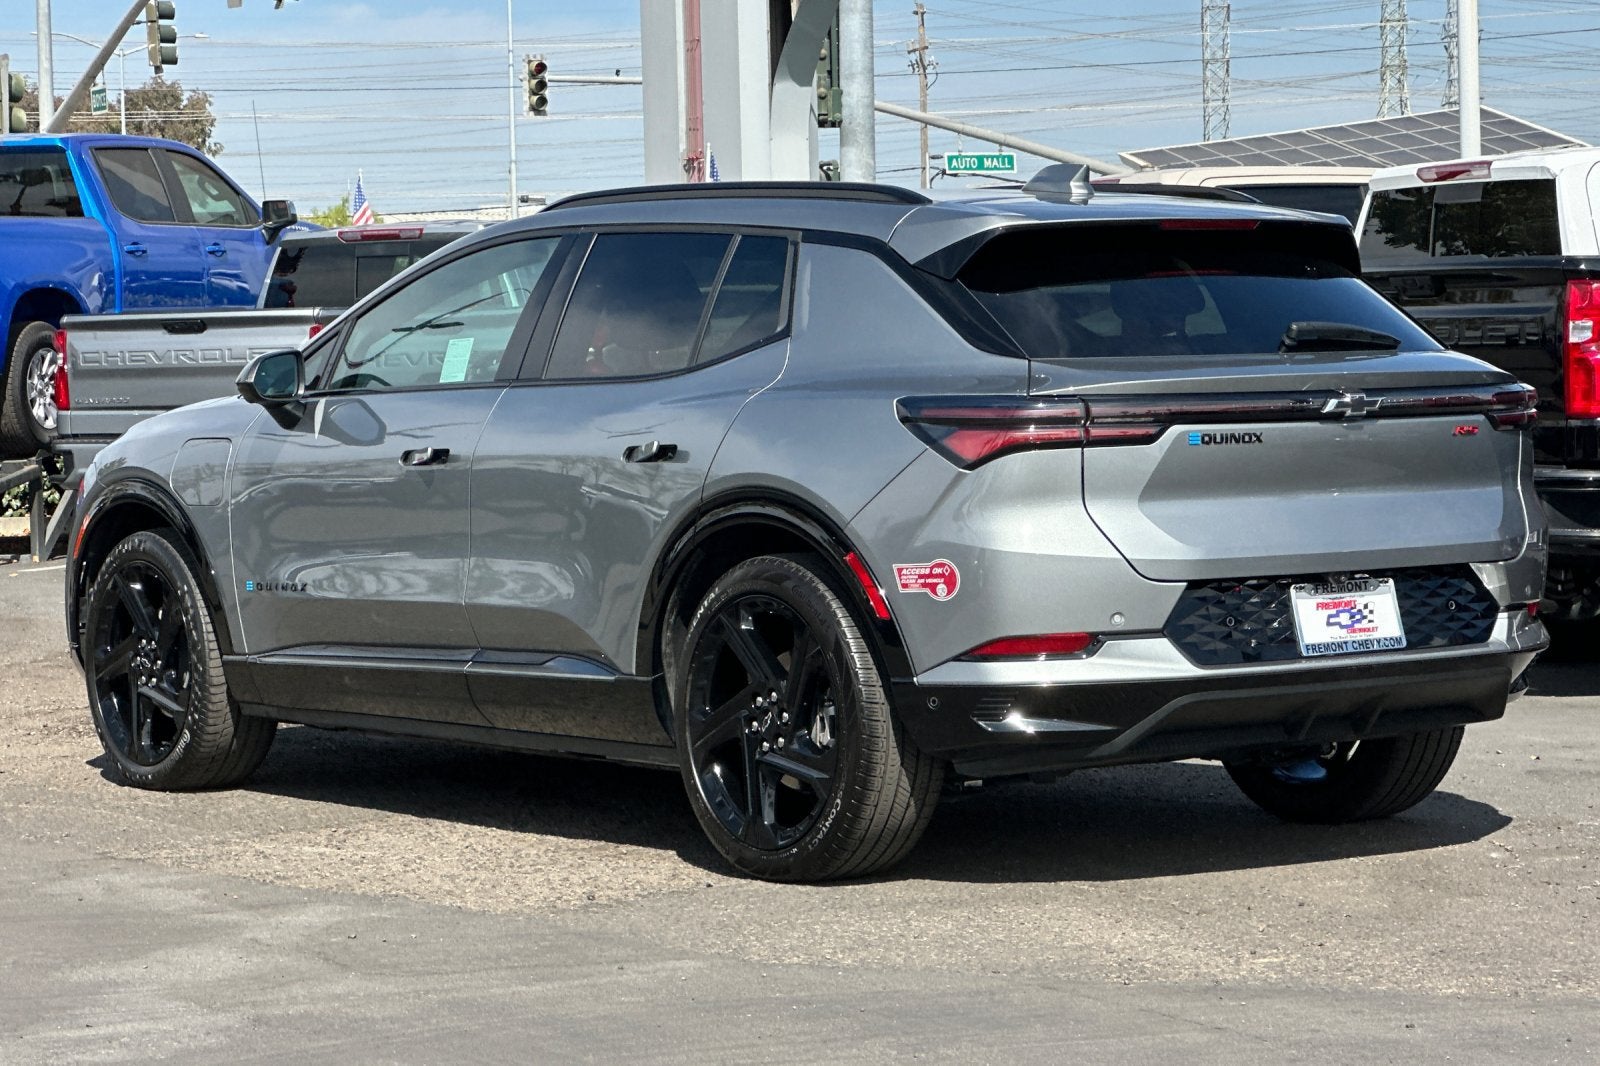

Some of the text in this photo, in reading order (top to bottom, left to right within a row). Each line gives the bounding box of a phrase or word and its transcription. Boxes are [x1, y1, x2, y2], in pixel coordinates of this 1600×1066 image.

[951, 157, 1011, 169] AUTO MALL
[1453, 425, 1479, 436] RS
[1188, 431, 1264, 446] EQUINOX
[245, 579, 308, 592] EQUINOX
[1315, 580, 1369, 594] FREMONT
[1316, 599, 1357, 611] FREMONT
[1346, 626, 1379, 634] CHEVROLET
[1305, 636, 1403, 655] FREMONT CHEVY.COM
